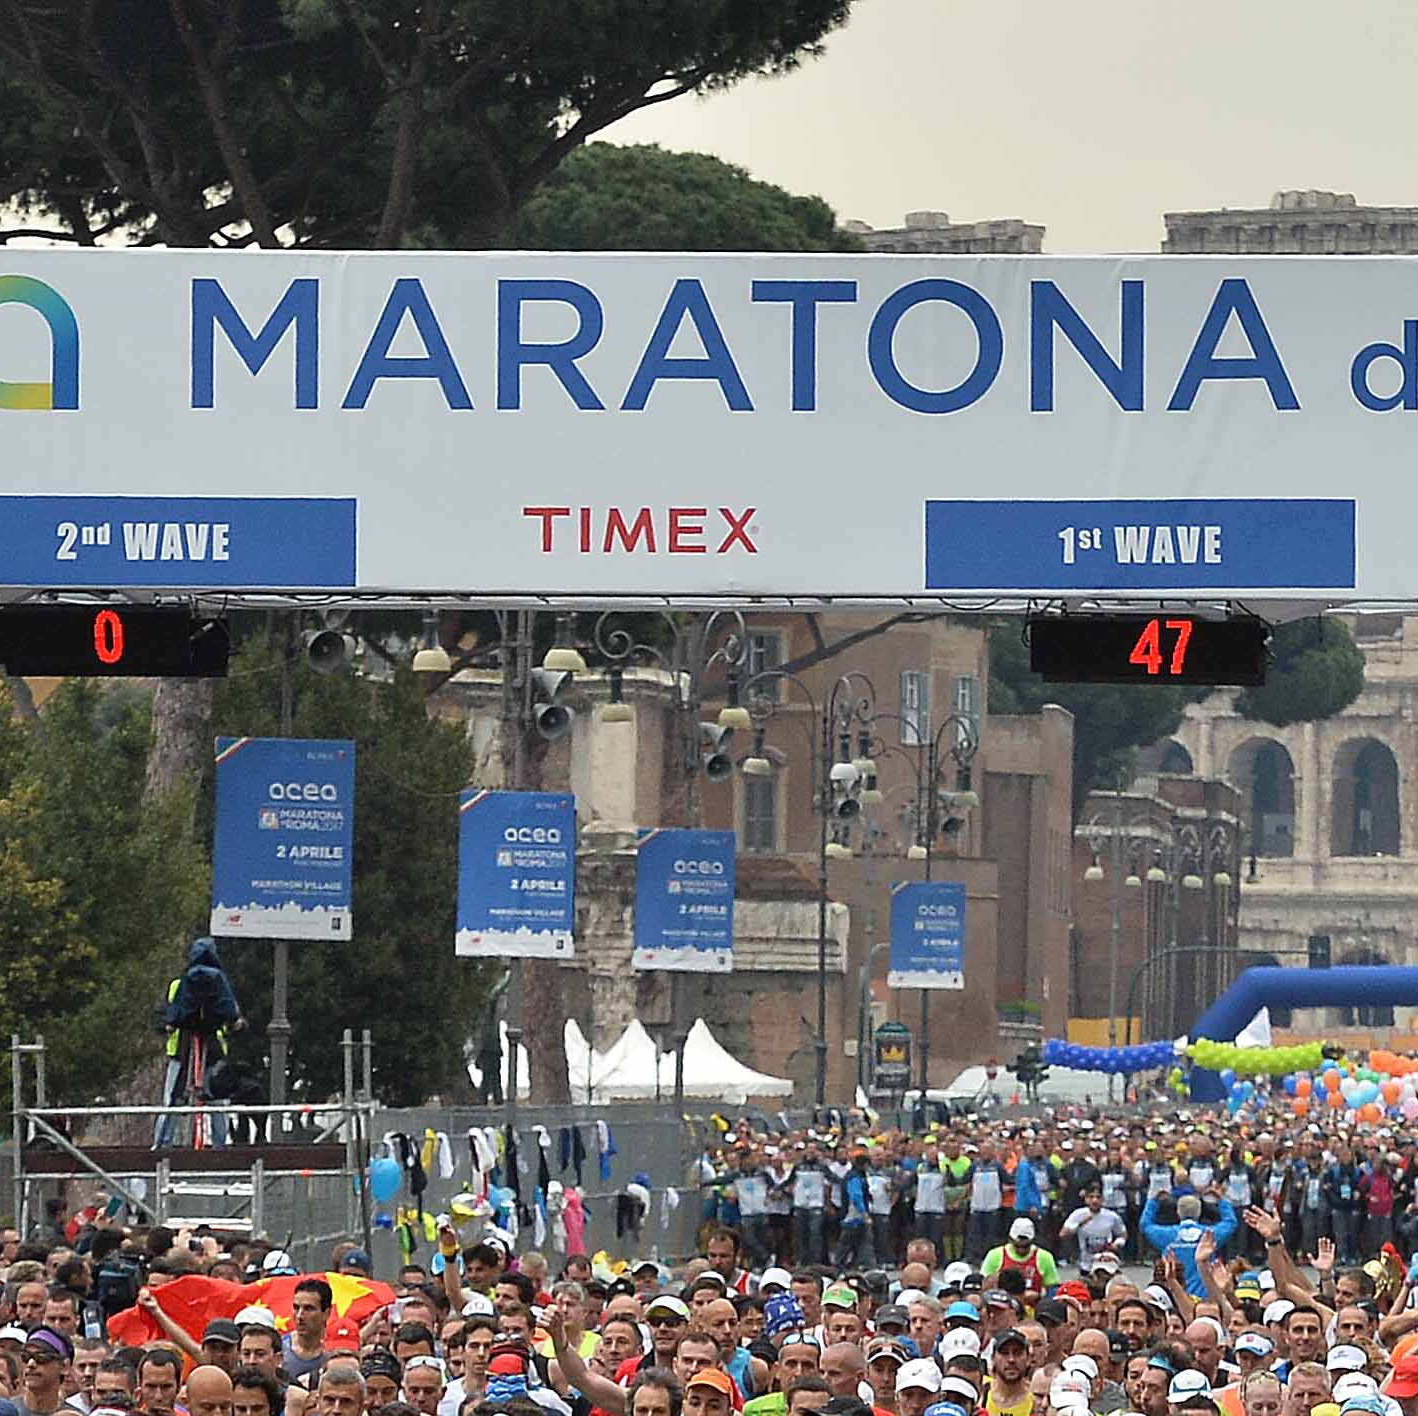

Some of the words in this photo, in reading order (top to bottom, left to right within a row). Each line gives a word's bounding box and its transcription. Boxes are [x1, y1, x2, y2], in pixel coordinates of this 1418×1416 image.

[191, 277, 1301, 413] MARATONA
[56, 521, 112, 562] 2nd
[124, 522, 231, 562] WAVE
[524, 506, 759, 554] TIMEX
[1058, 526, 1102, 566] 1st
[1115, 525, 1223, 566] WAVE
[93, 608, 125, 665] 0
[1128, 618, 1193, 676] 47
[269, 783, 337, 801] acea
[280, 810, 344, 821] MARATONA
[504, 827, 562, 843] acea
[277, 846, 287, 858] 2
[289, 845, 344, 859] APRILE
[673, 860, 724, 875] acea
[510, 879, 520, 891] 2
[521, 879, 566, 891] APRILE
